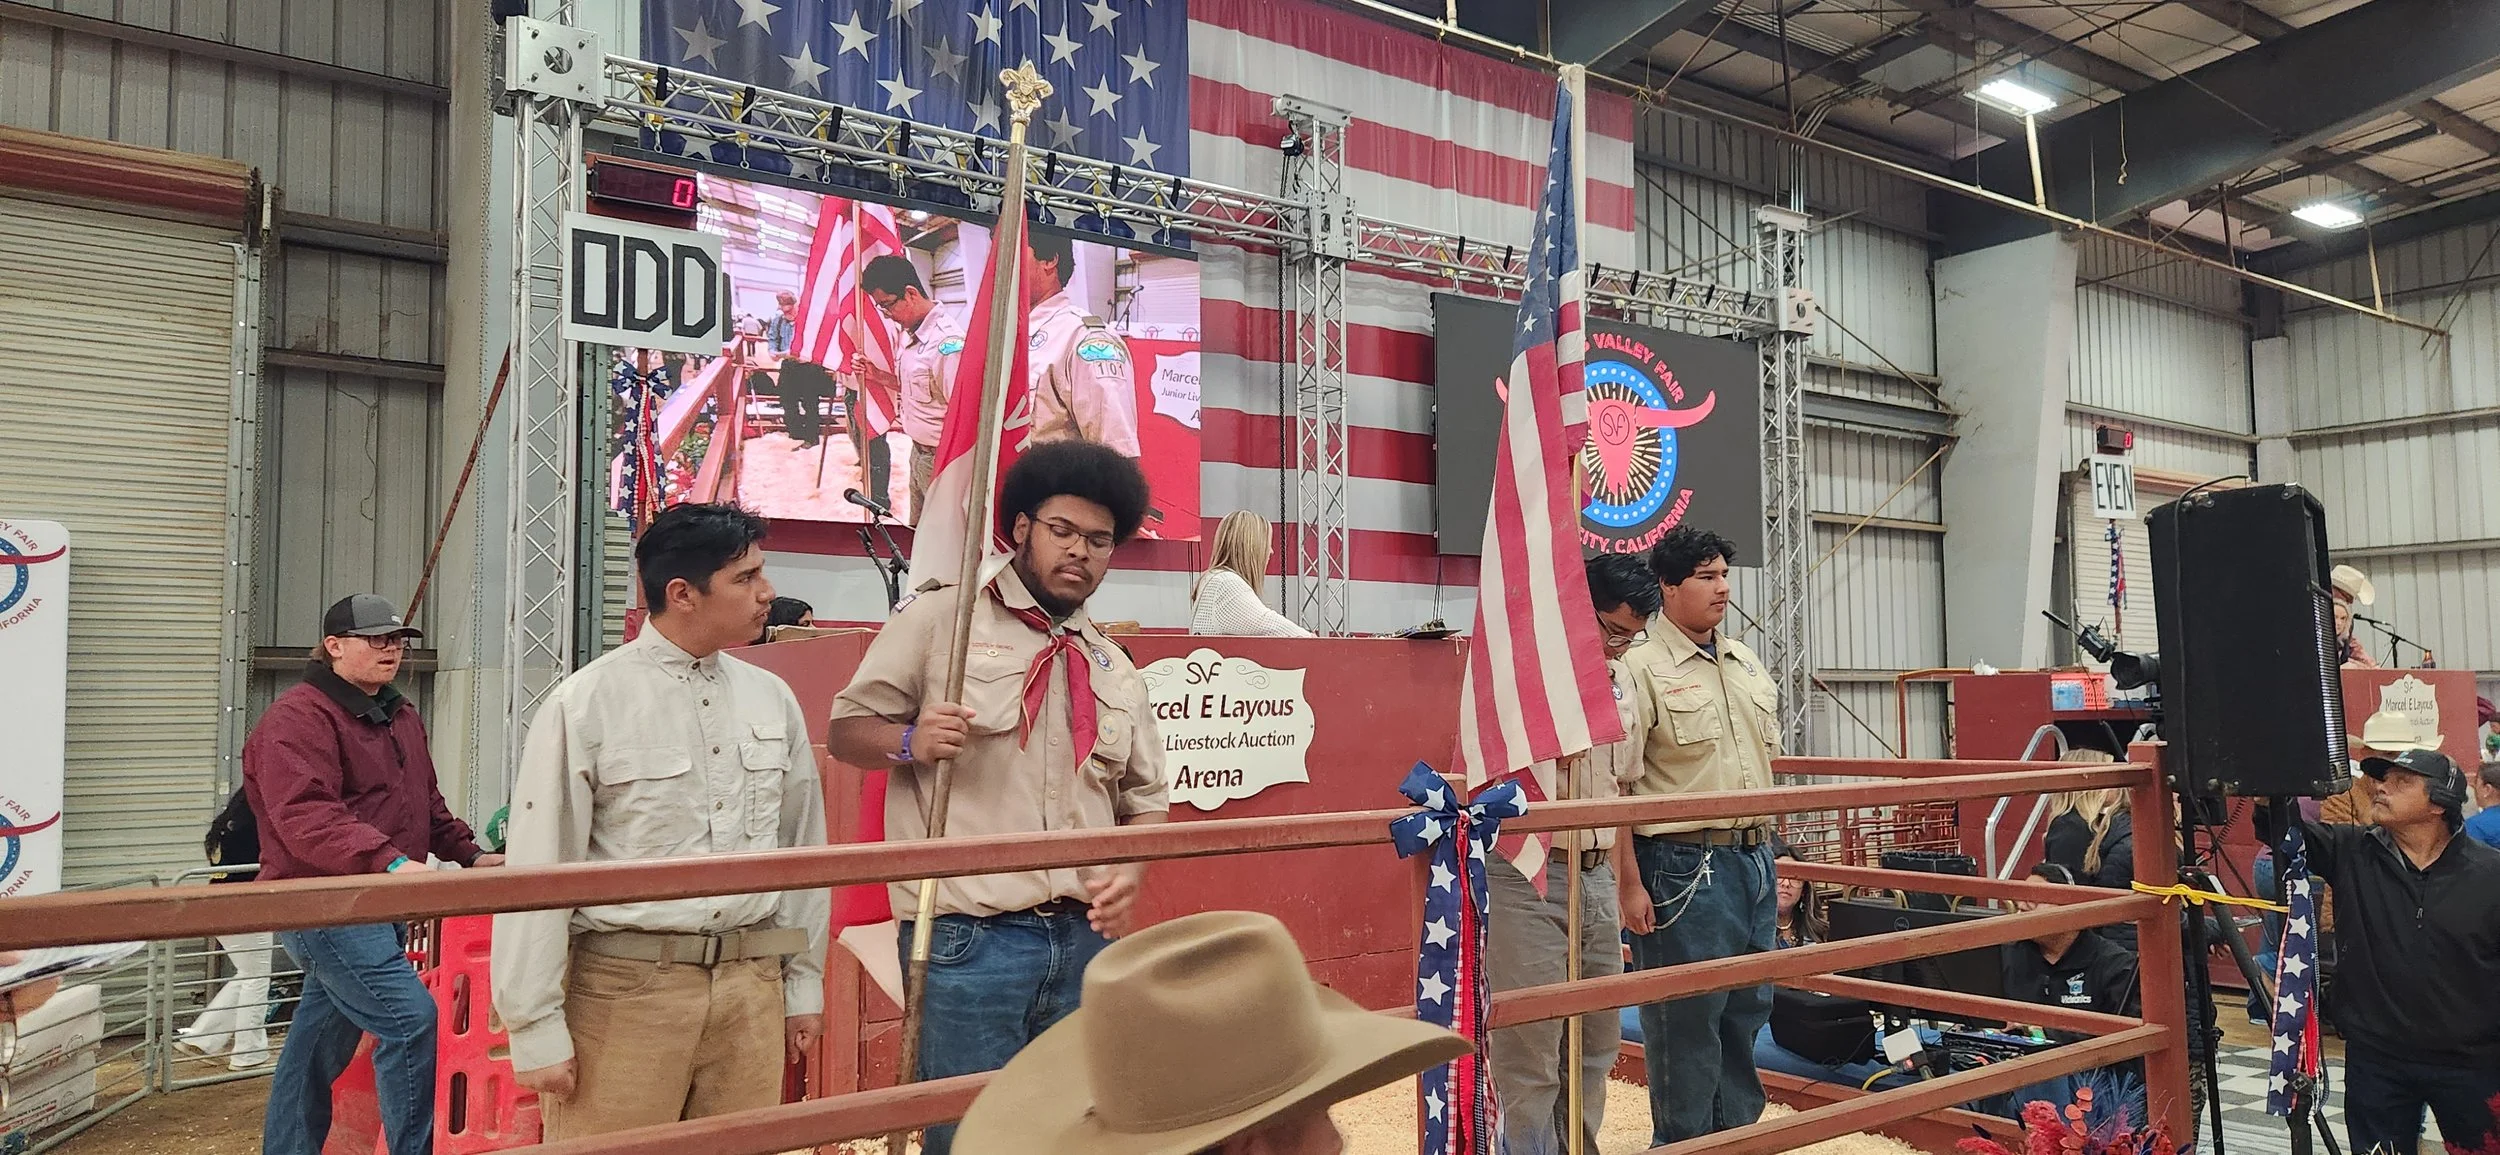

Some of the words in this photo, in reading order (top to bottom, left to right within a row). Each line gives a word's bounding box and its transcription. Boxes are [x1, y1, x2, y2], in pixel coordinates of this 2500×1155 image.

[672, 178, 695, 208] 0
[571, 228, 716, 338] ODD
[1592, 332, 1655, 364] VALLEY
[1653, 359, 1685, 404] FAIR
[1161, 387, 1186, 399] Junior
[2095, 462, 2134, 511] EVEN
[1614, 488, 1694, 554] CALIFORNIA
[13, 529, 38, 551] FAIR
[1185, 661, 1222, 685] SVF
[1200, 694, 1214, 719] E
[1220, 694, 1294, 725] Layous
[1166, 731, 1237, 752] Livestock
[1238, 729, 1295, 749] Auction
[1173, 765, 1243, 790] Arena
[5, 799, 31, 821] FAIR
